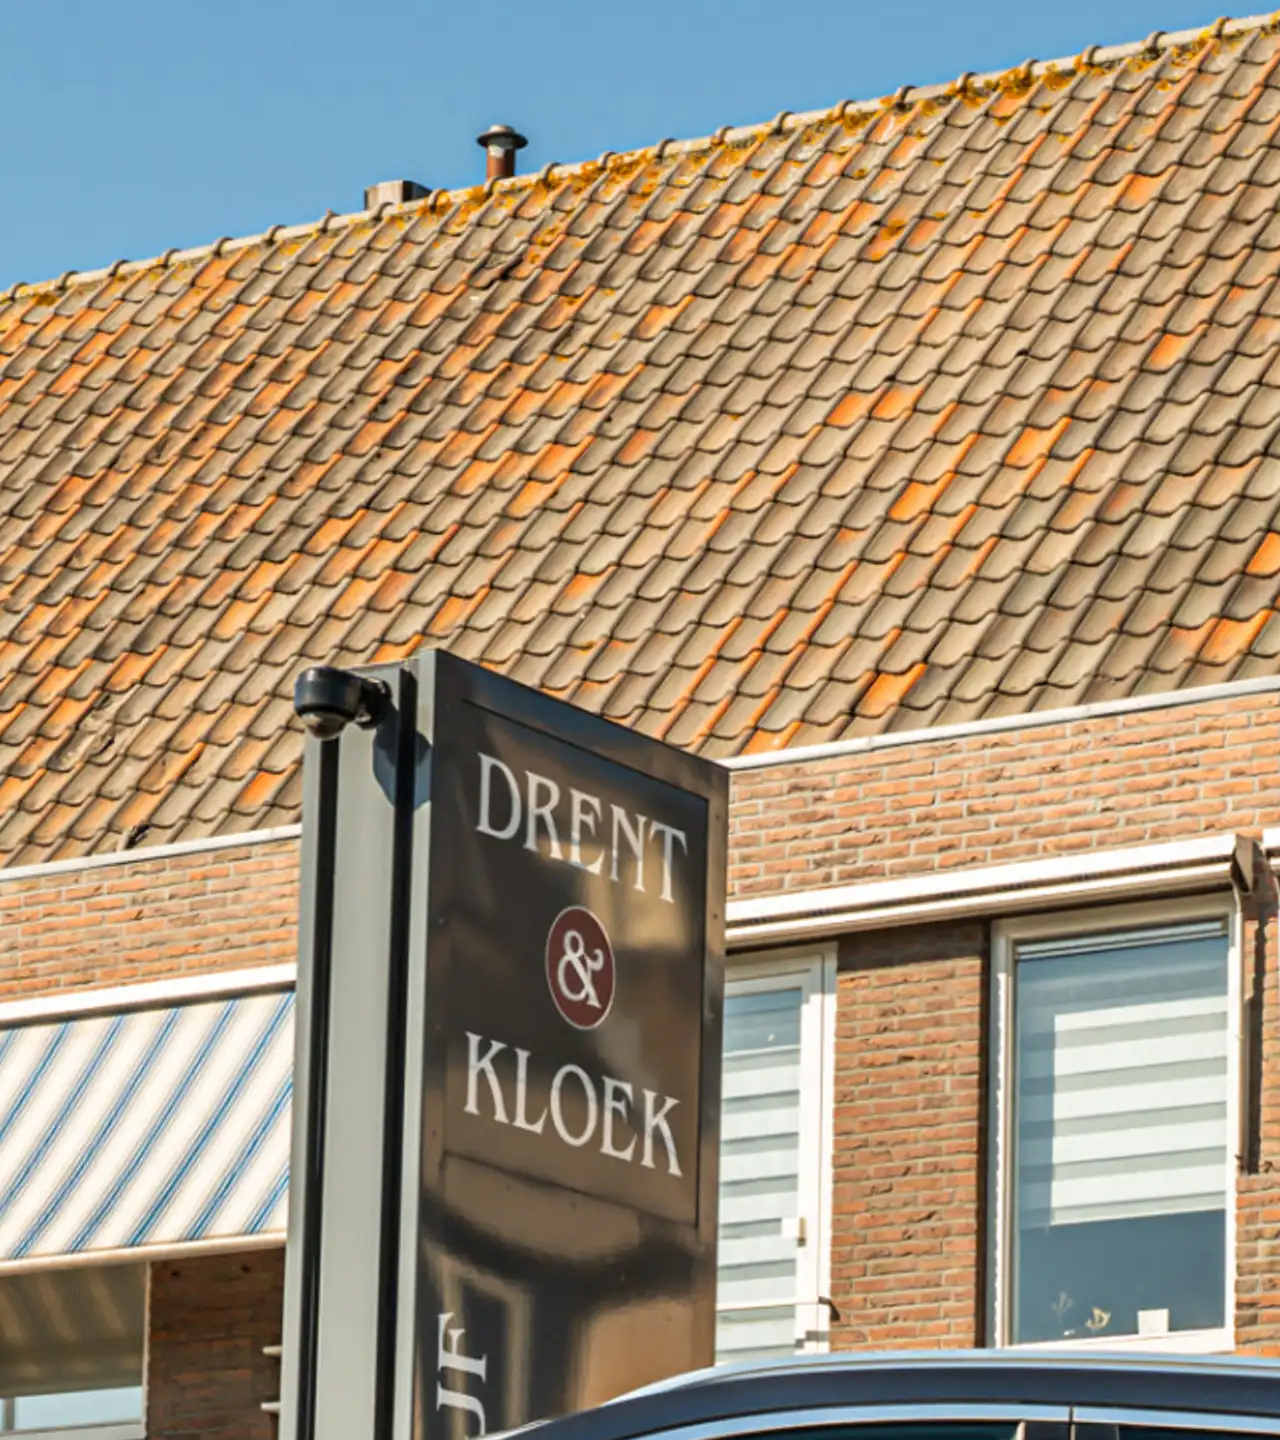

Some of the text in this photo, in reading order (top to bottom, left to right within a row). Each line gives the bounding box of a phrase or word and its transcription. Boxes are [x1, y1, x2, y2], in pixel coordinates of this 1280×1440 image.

[475, 752, 688, 904] DRENT
[556, 929, 605, 1010] &
[463, 1031, 684, 1179] KLOEK
